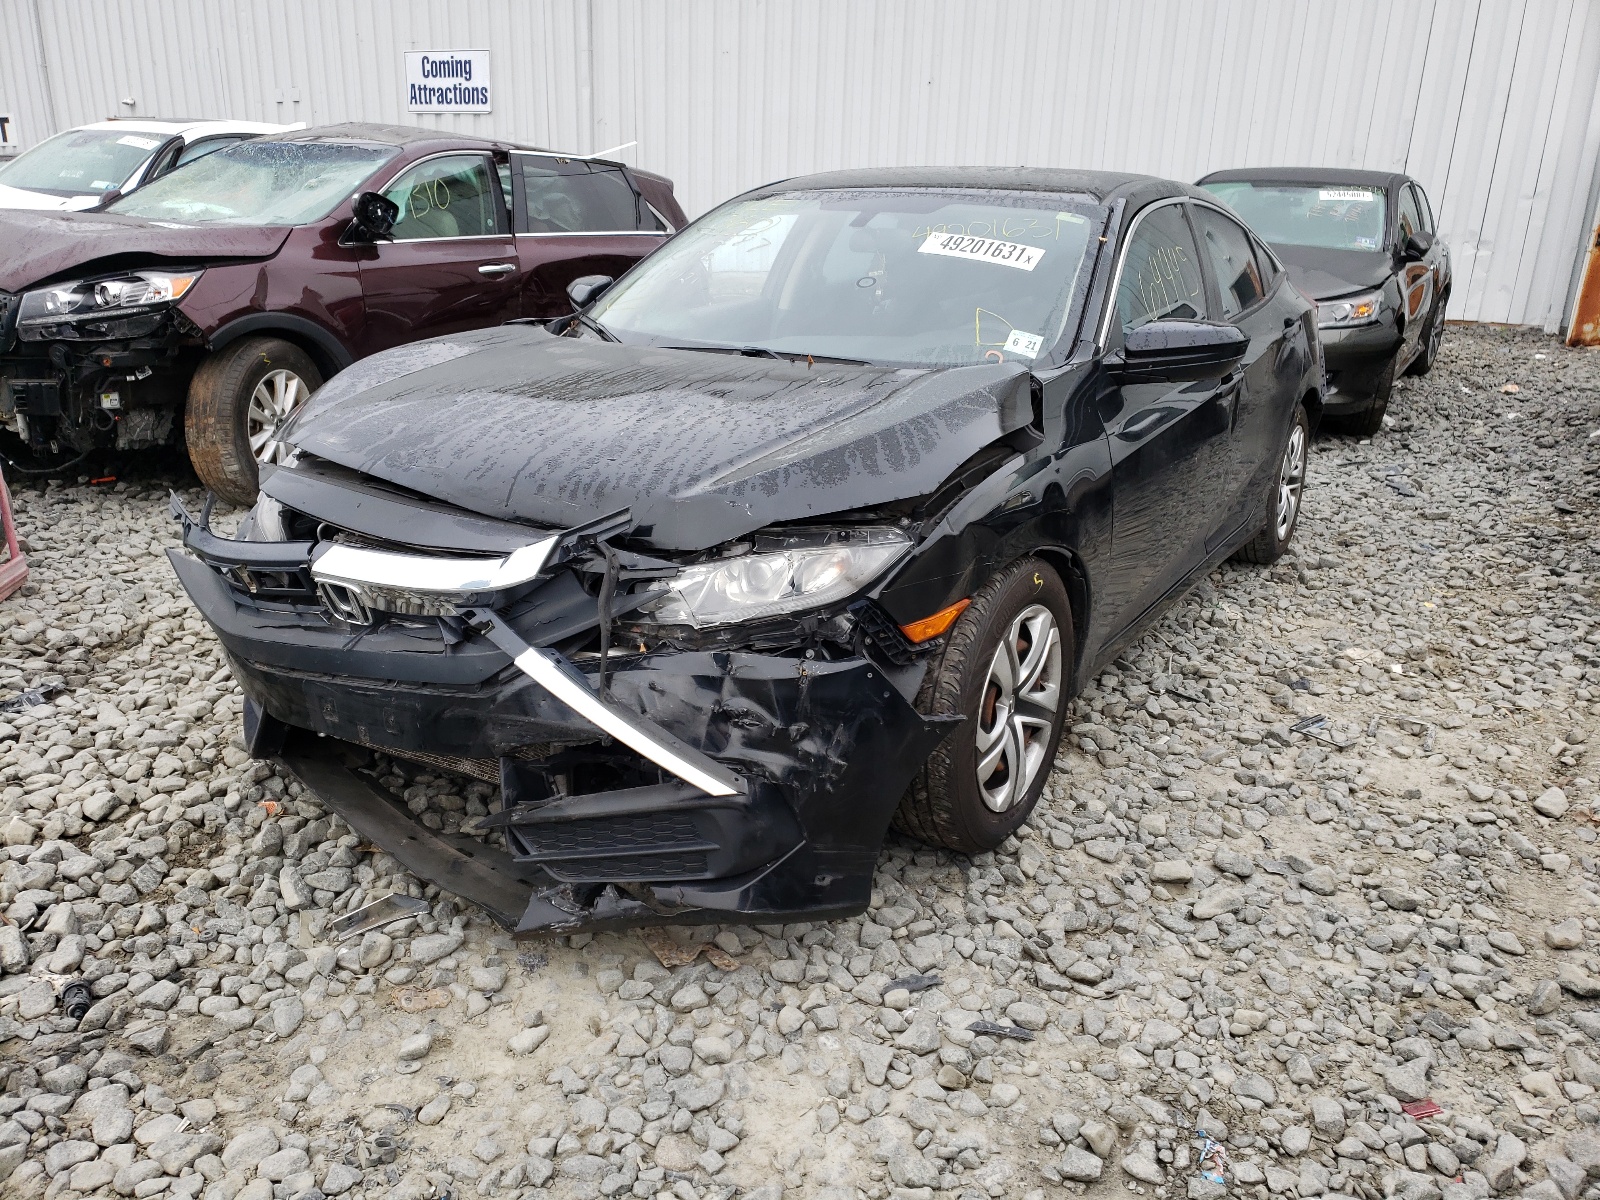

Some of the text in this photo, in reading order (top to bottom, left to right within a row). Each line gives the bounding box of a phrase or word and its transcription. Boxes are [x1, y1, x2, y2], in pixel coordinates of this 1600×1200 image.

[421, 55, 472, 81] Coming
[409, 82, 488, 105] Attractions
[911, 217, 1060, 241] 49201631
[1012, 337, 1037, 351] 6 21
